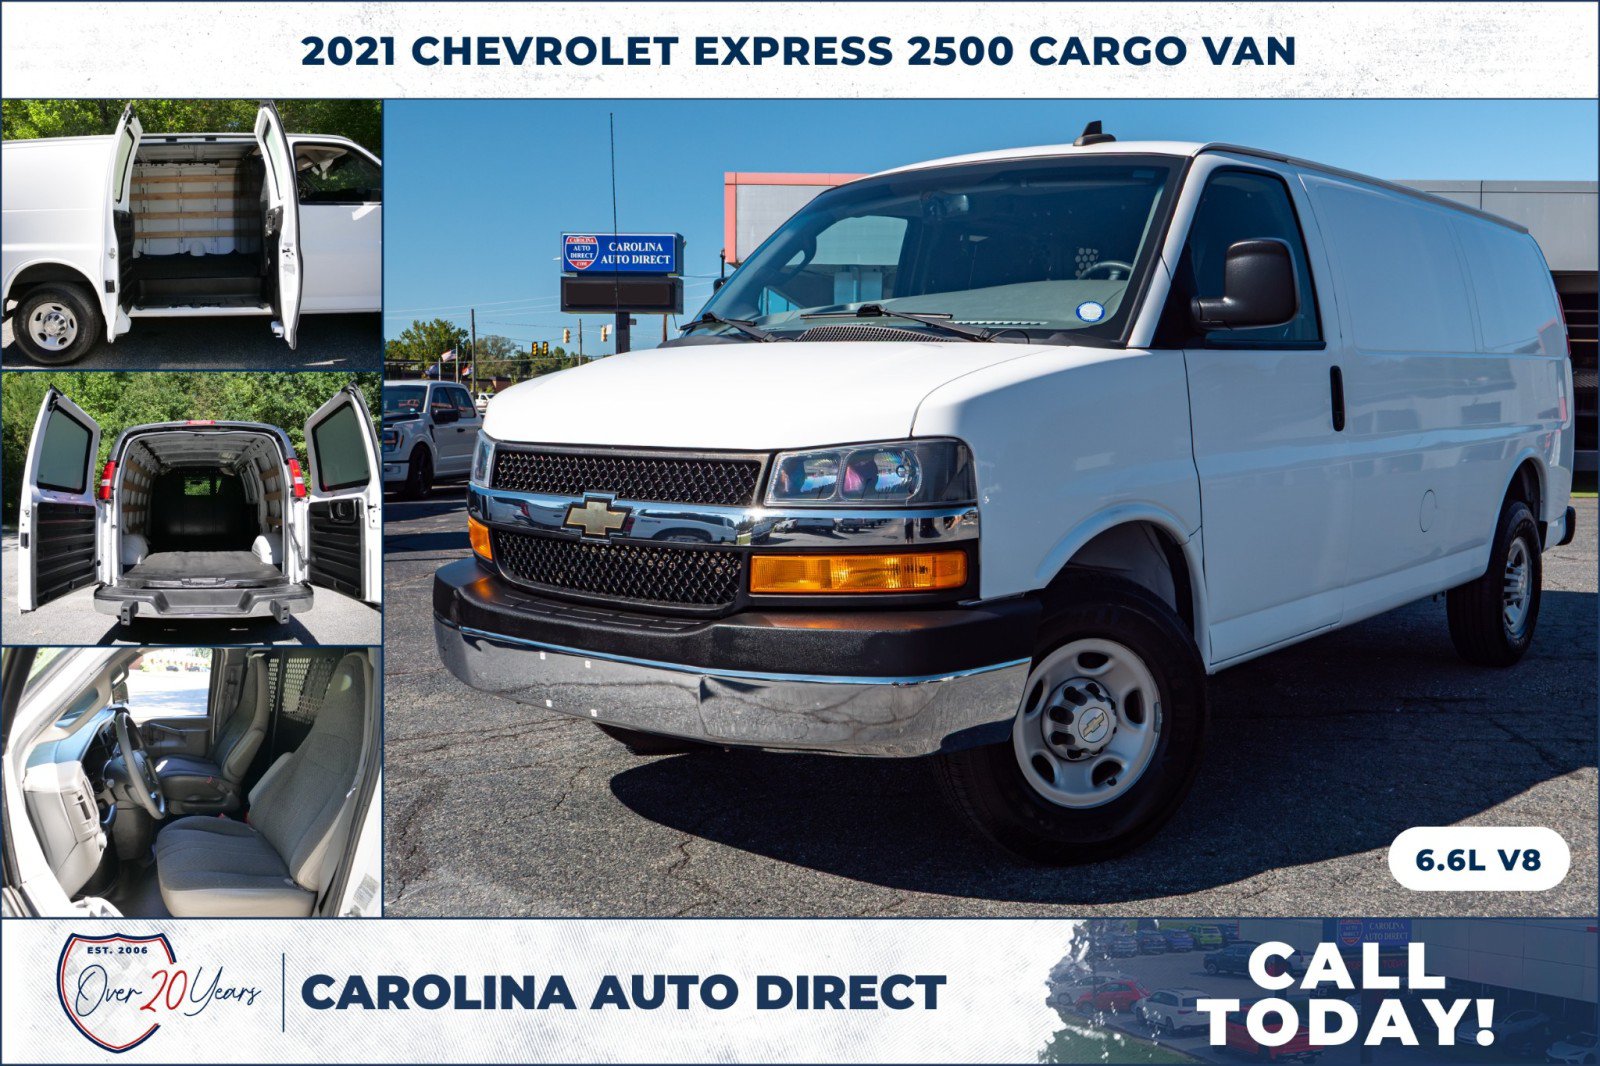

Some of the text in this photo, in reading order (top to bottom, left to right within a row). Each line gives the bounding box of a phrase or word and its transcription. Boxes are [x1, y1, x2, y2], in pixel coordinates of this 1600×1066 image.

[608, 242, 663, 252] CAROLINA
[601, 255, 671, 264] AUTO DIRECT
[1369, 922, 1405, 930] CAROLINA
[1364, 933, 1383, 941] AUTO
[1384, 932, 1408, 940] DIRECT
